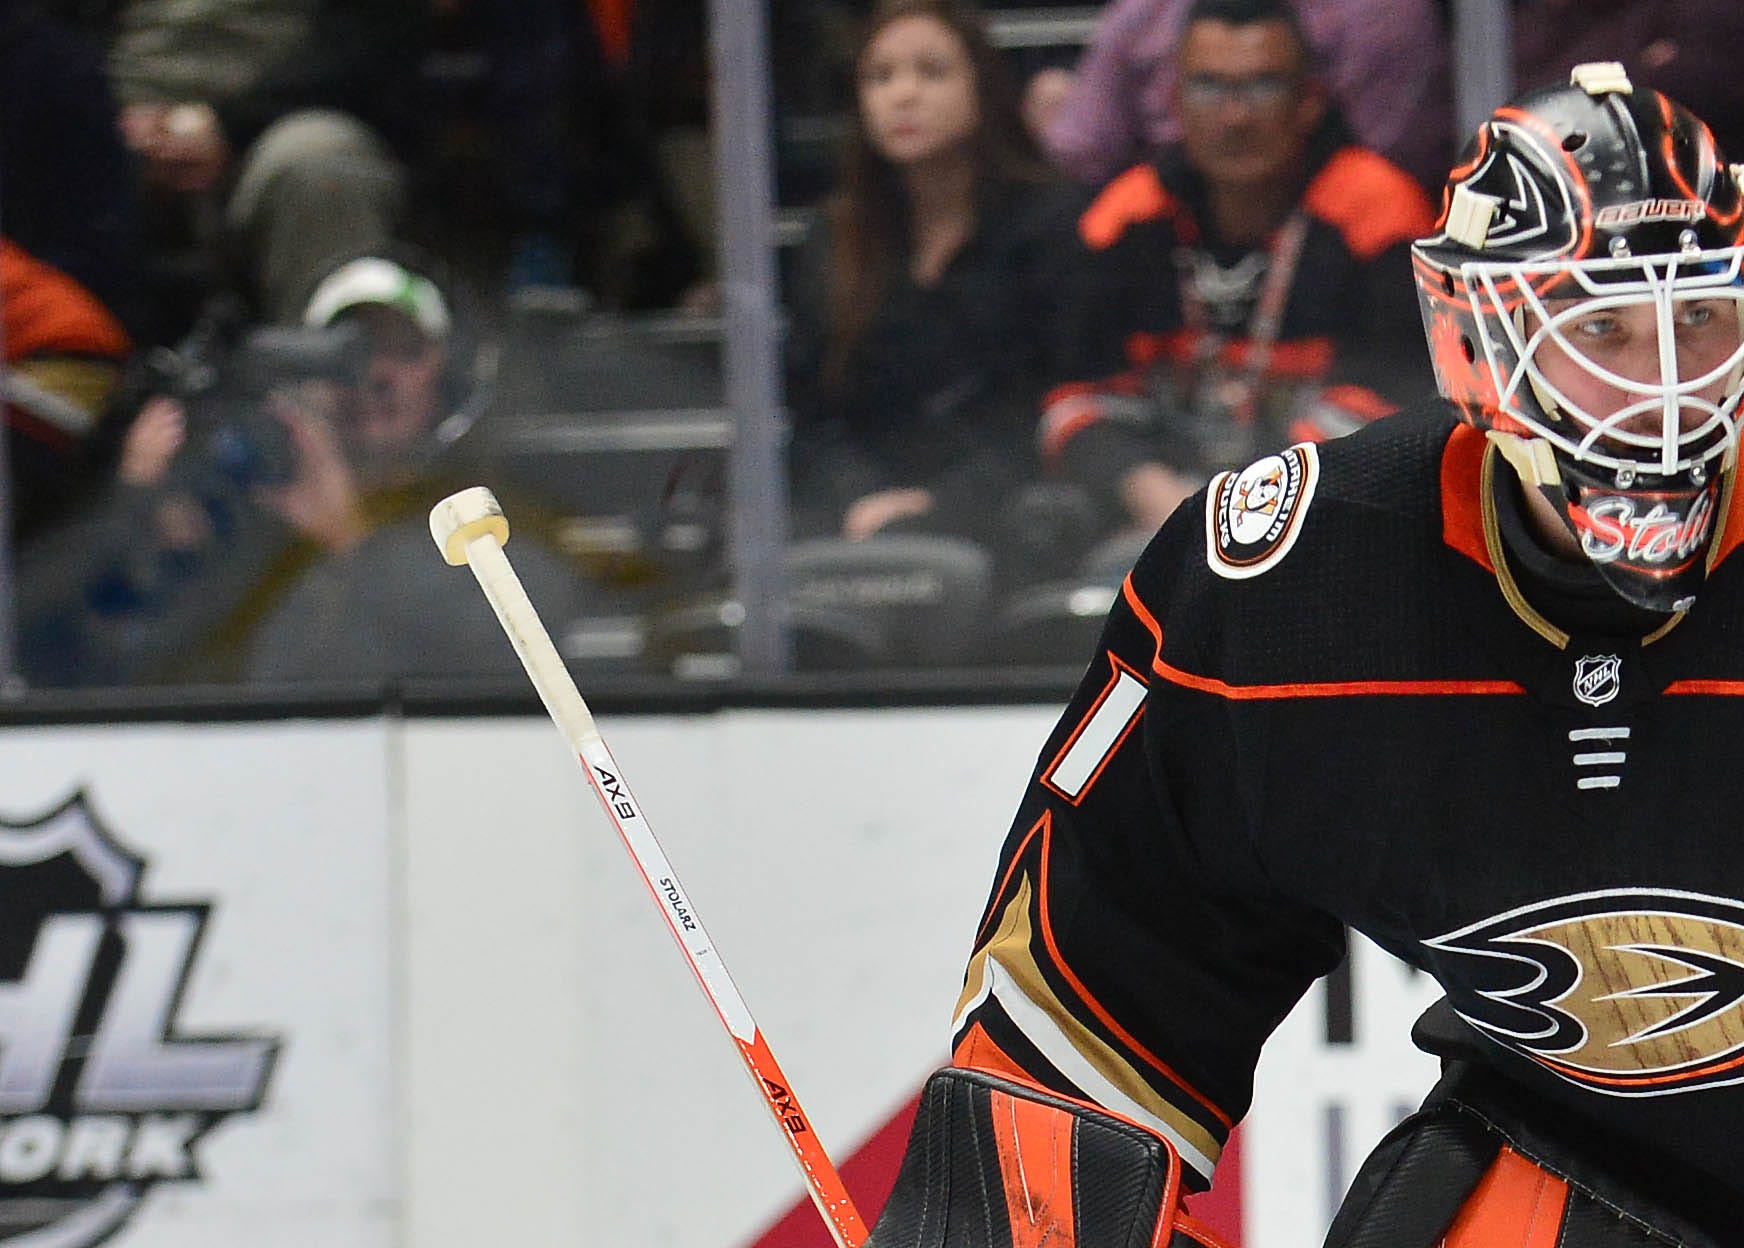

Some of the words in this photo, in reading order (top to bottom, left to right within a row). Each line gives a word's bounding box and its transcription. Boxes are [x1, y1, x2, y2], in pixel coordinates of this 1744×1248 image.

[1583, 665, 1612, 693] NHL
[659, 877, 697, 932] STOLARZ
[0, 1112, 197, 1184] ORK
